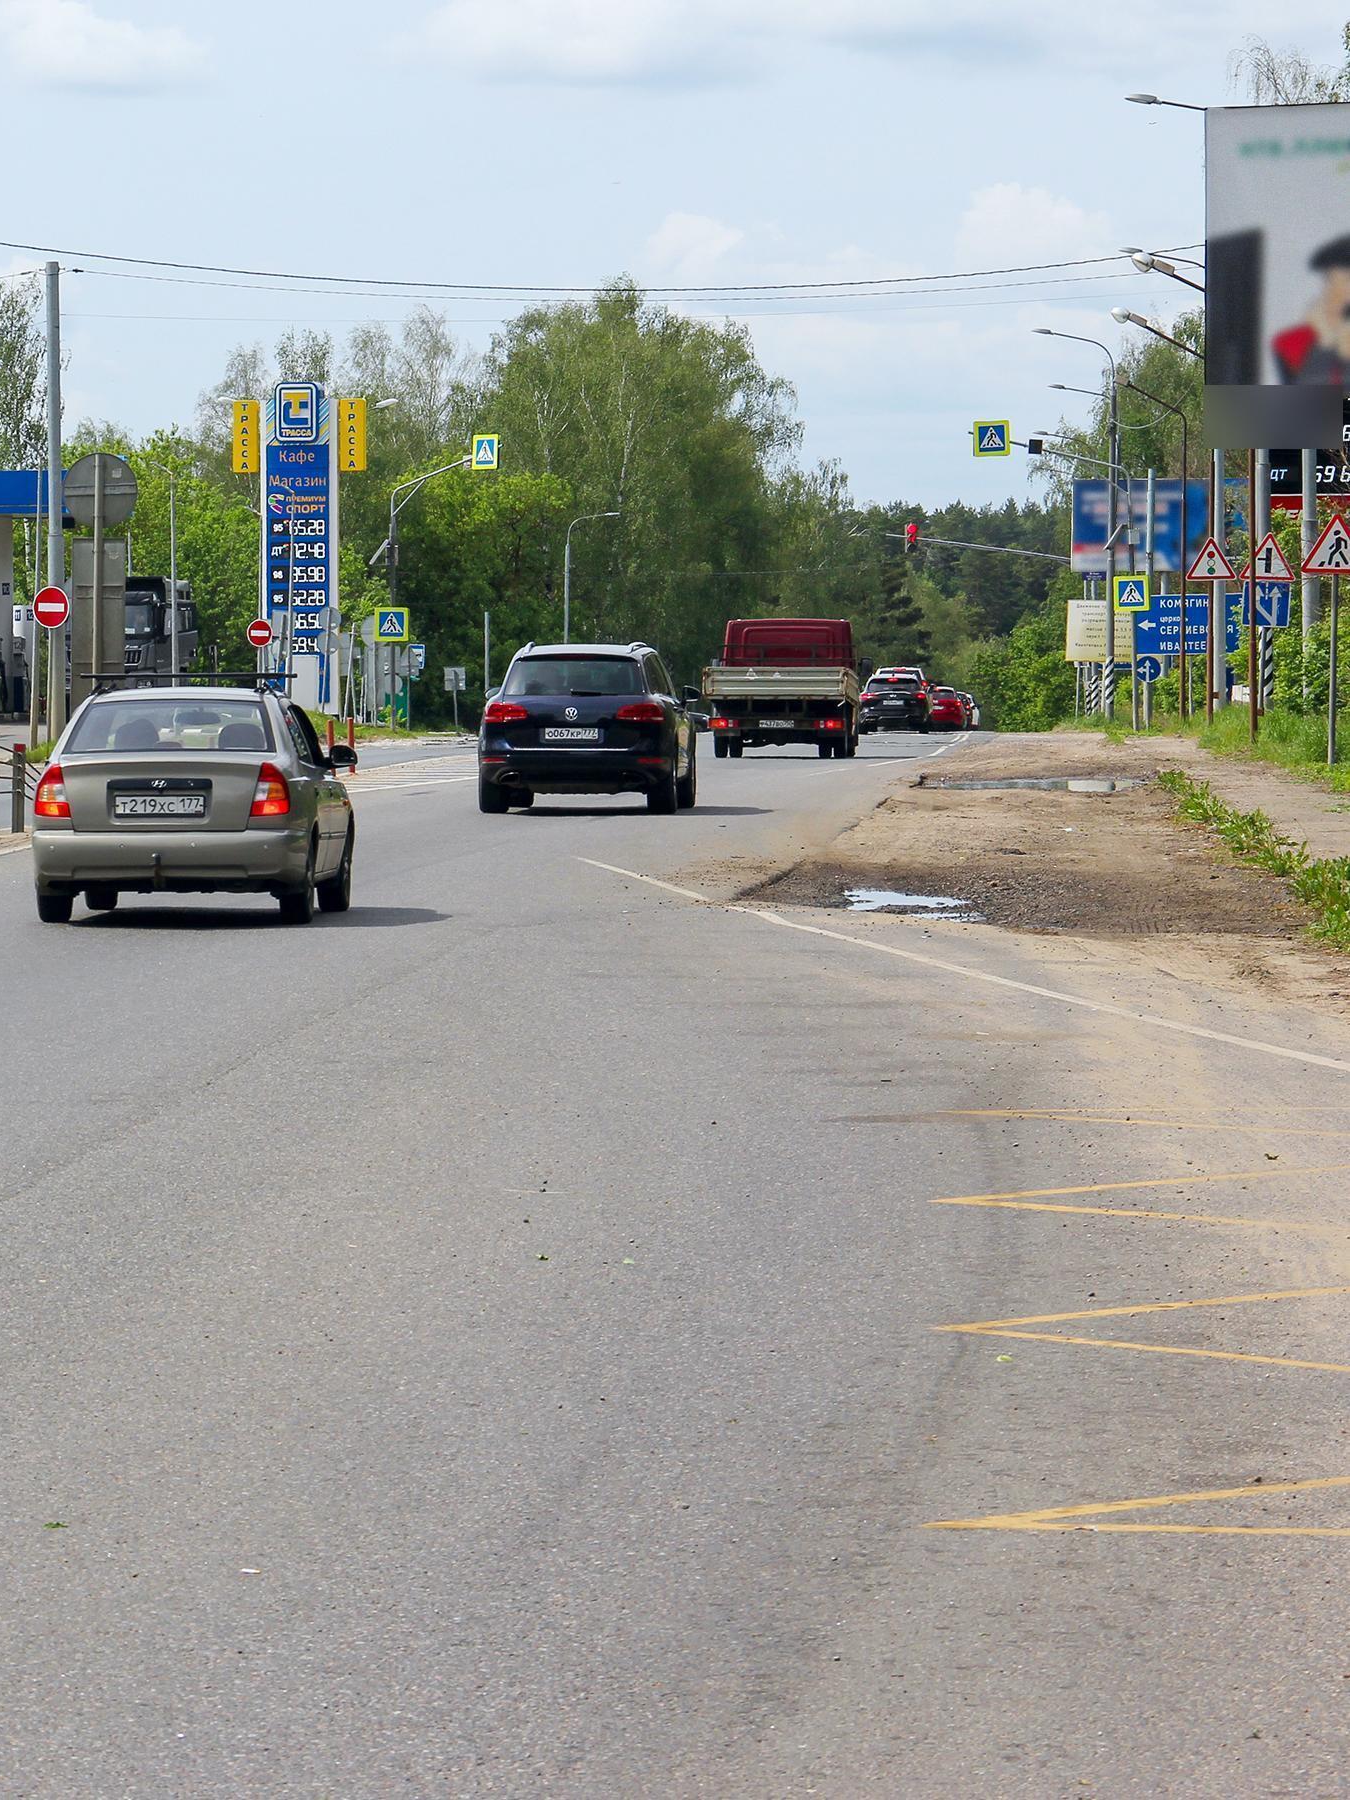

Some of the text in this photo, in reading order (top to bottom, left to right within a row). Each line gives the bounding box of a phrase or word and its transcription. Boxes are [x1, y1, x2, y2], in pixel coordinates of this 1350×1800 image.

[241, 403, 249, 470] ТРАССА
[281, 429, 312, 437] ТРАССА
[348, 402, 356, 468] ТРАССА
[279, 450, 315, 464] Кафе
[269, 475, 327, 487] Магазин
[286, 504, 325, 513] СПОРТ
[271, 546, 283, 556] ДТ
[1160, 599, 1210, 608] КОМЯГИН
[120, 798, 200, 812] Т219ХС 177
